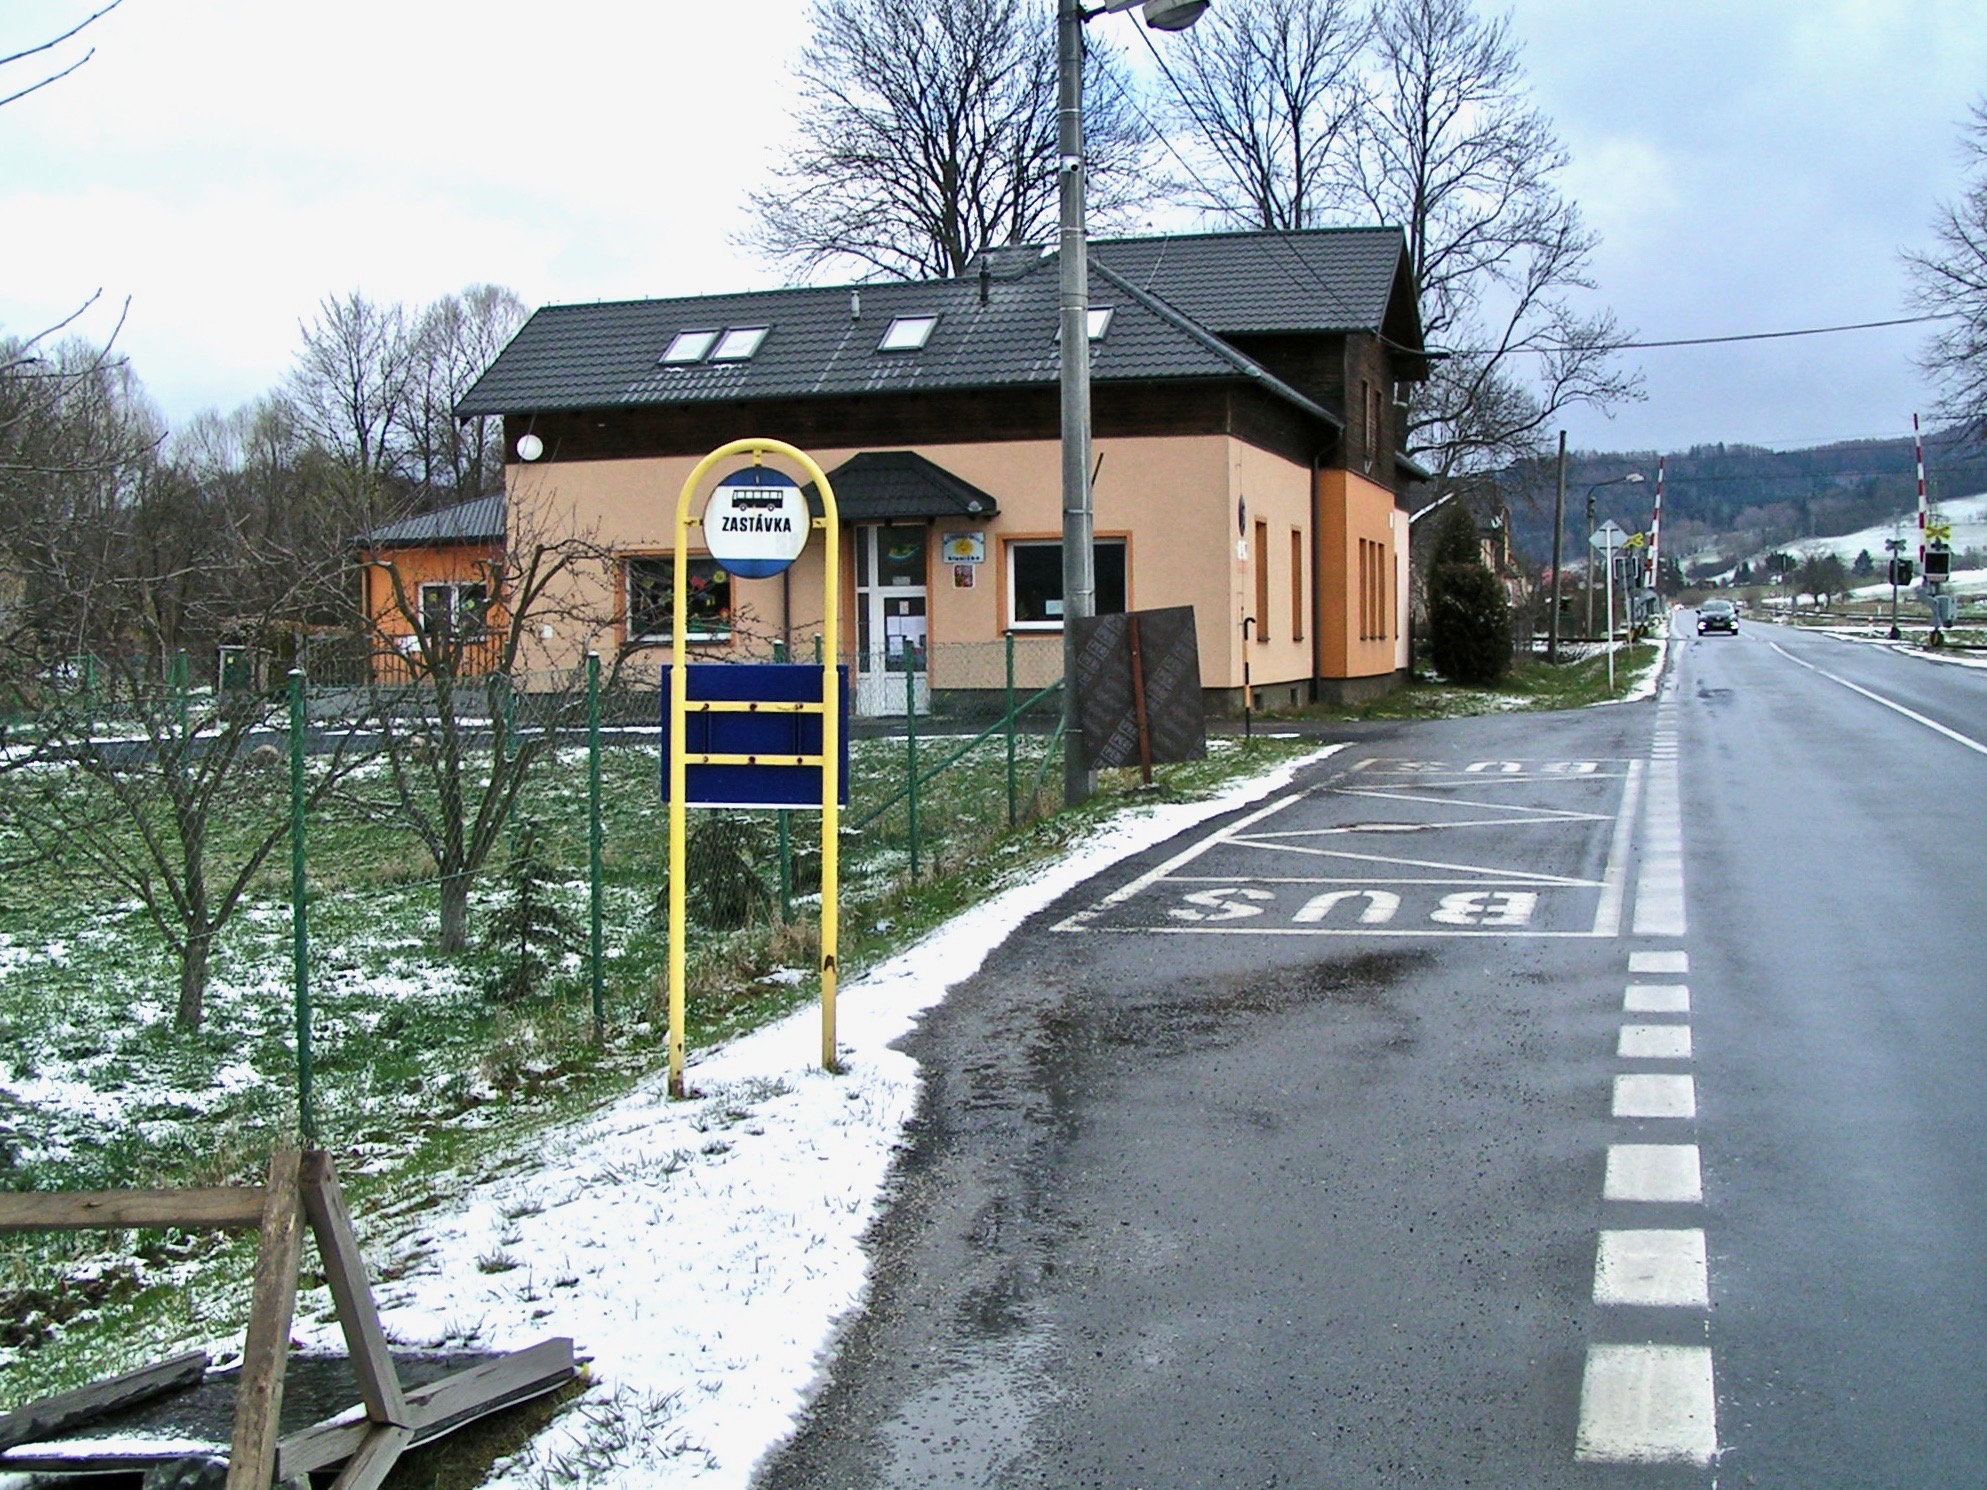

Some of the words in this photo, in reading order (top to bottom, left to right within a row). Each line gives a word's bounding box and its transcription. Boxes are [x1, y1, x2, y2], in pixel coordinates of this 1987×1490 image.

[722, 514, 791, 533] ZASTÁVKA
[1398, 761, 1599, 773] BUS
[1168, 888, 1538, 926] BUS
